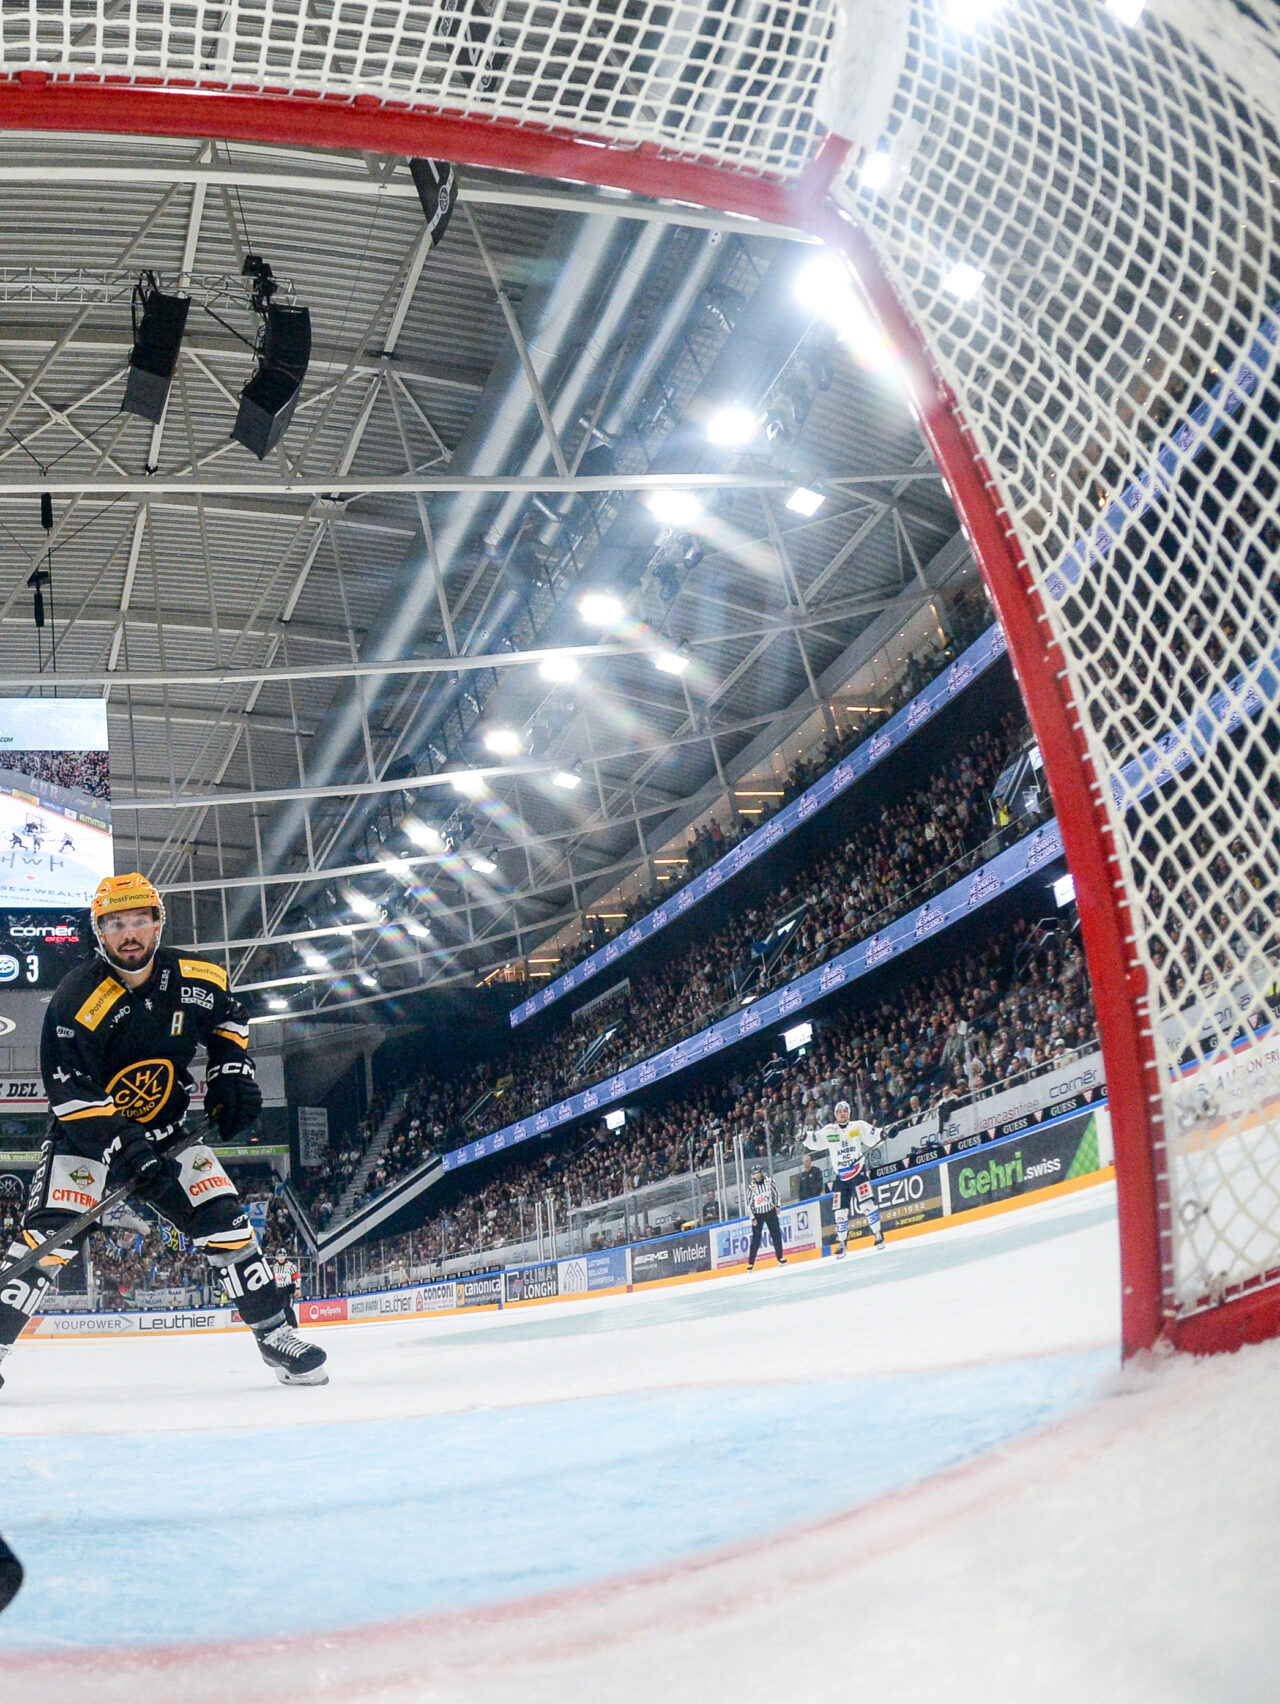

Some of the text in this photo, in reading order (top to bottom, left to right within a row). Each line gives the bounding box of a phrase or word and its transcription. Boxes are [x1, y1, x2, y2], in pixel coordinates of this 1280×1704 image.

[26, 955, 39, 982] 3
[171, 1011, 185, 1036] A
[207, 1062, 255, 1081] CCM
[6, 1082, 37, 1097] DEL
[121, 1101, 156, 1118] LUGANO
[1050, 1099, 1077, 1116] GUESS
[1003, 1118, 1028, 1134] GUESS
[958, 1134, 982, 1149] GUESS
[916, 1151, 938, 1164] GUESS
[876, 1164, 898, 1176] GUESS
[672, 1243, 708, 1265] Winteler
[523, 1266, 552, 1285] CLIMA
[464, 1278, 501, 1296] canonica
[523, 1281, 557, 1299] LONGHI
[54, 1319, 122, 1331] YOUPOWER
[139, 1314, 216, 1330] Leuthier
